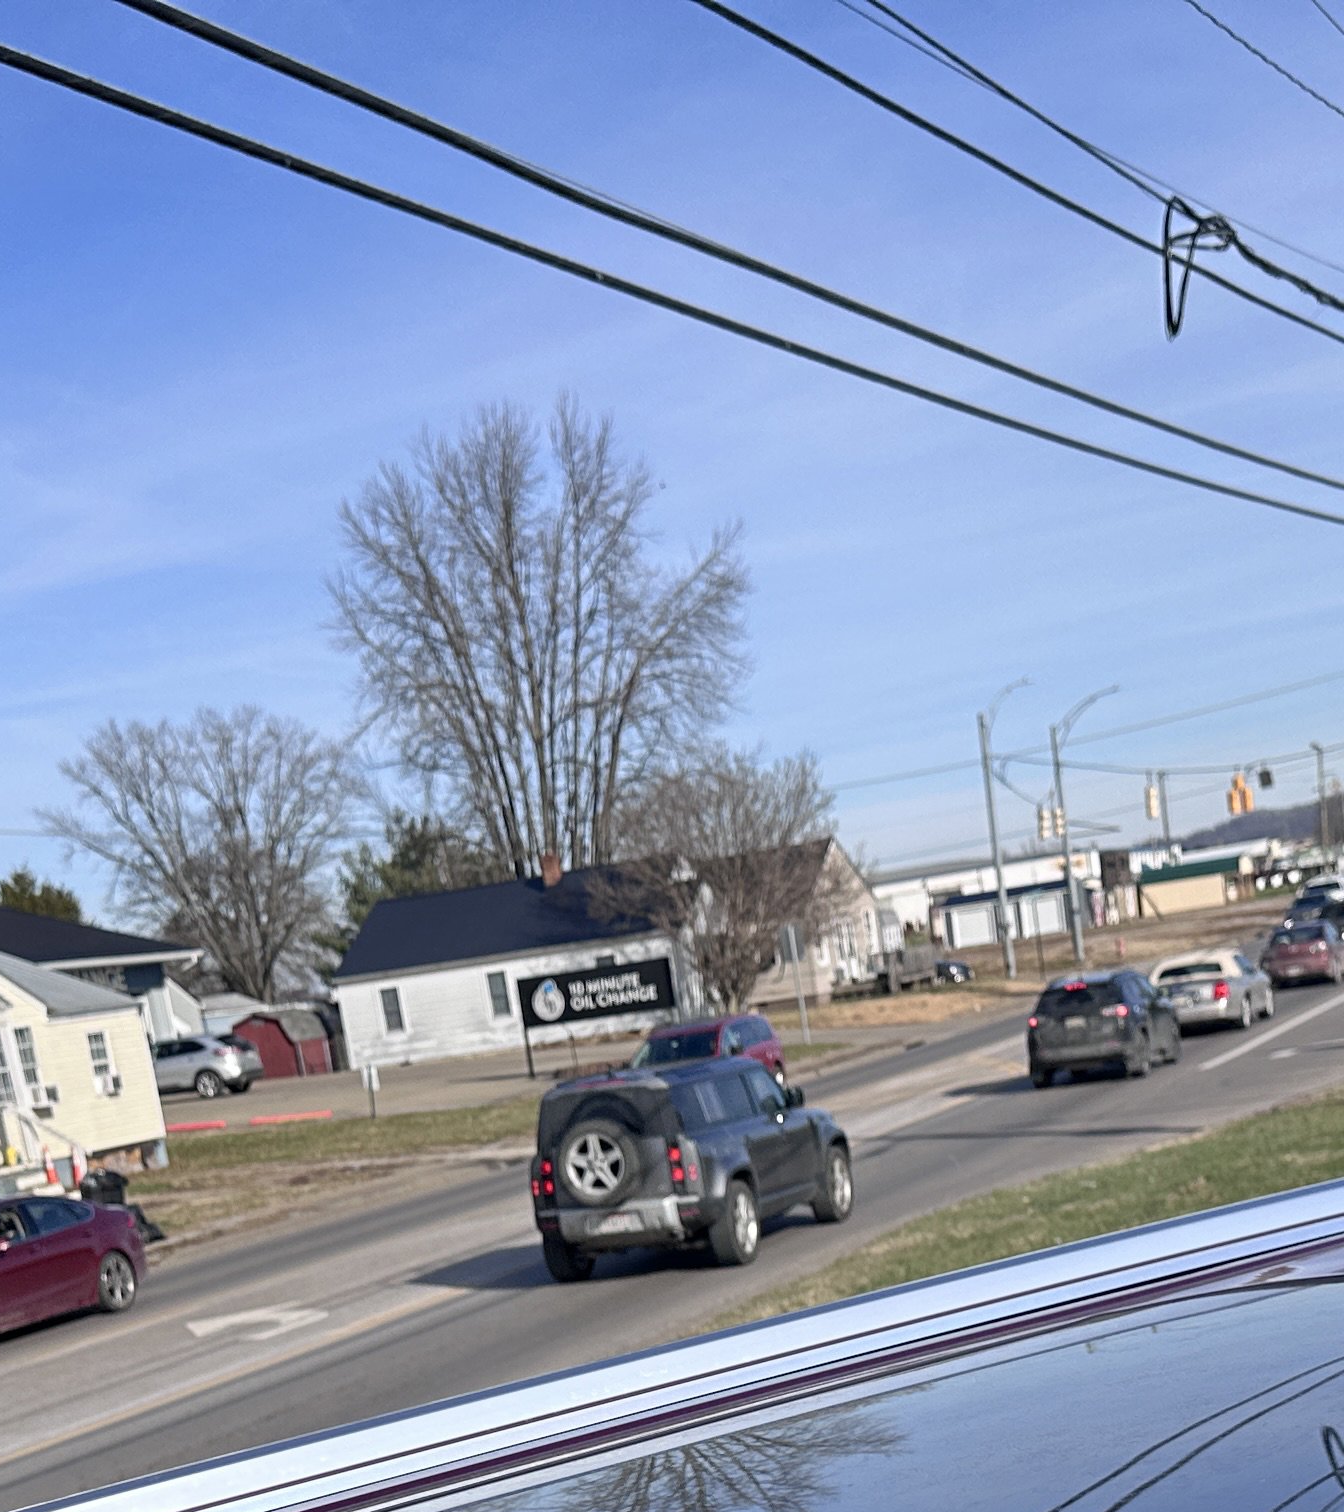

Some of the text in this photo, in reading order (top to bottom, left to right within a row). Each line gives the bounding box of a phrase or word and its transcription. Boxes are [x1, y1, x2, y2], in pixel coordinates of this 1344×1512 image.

[585, 971, 641, 994] MINUTE
[570, 983, 658, 1012] OIL CHANGE
